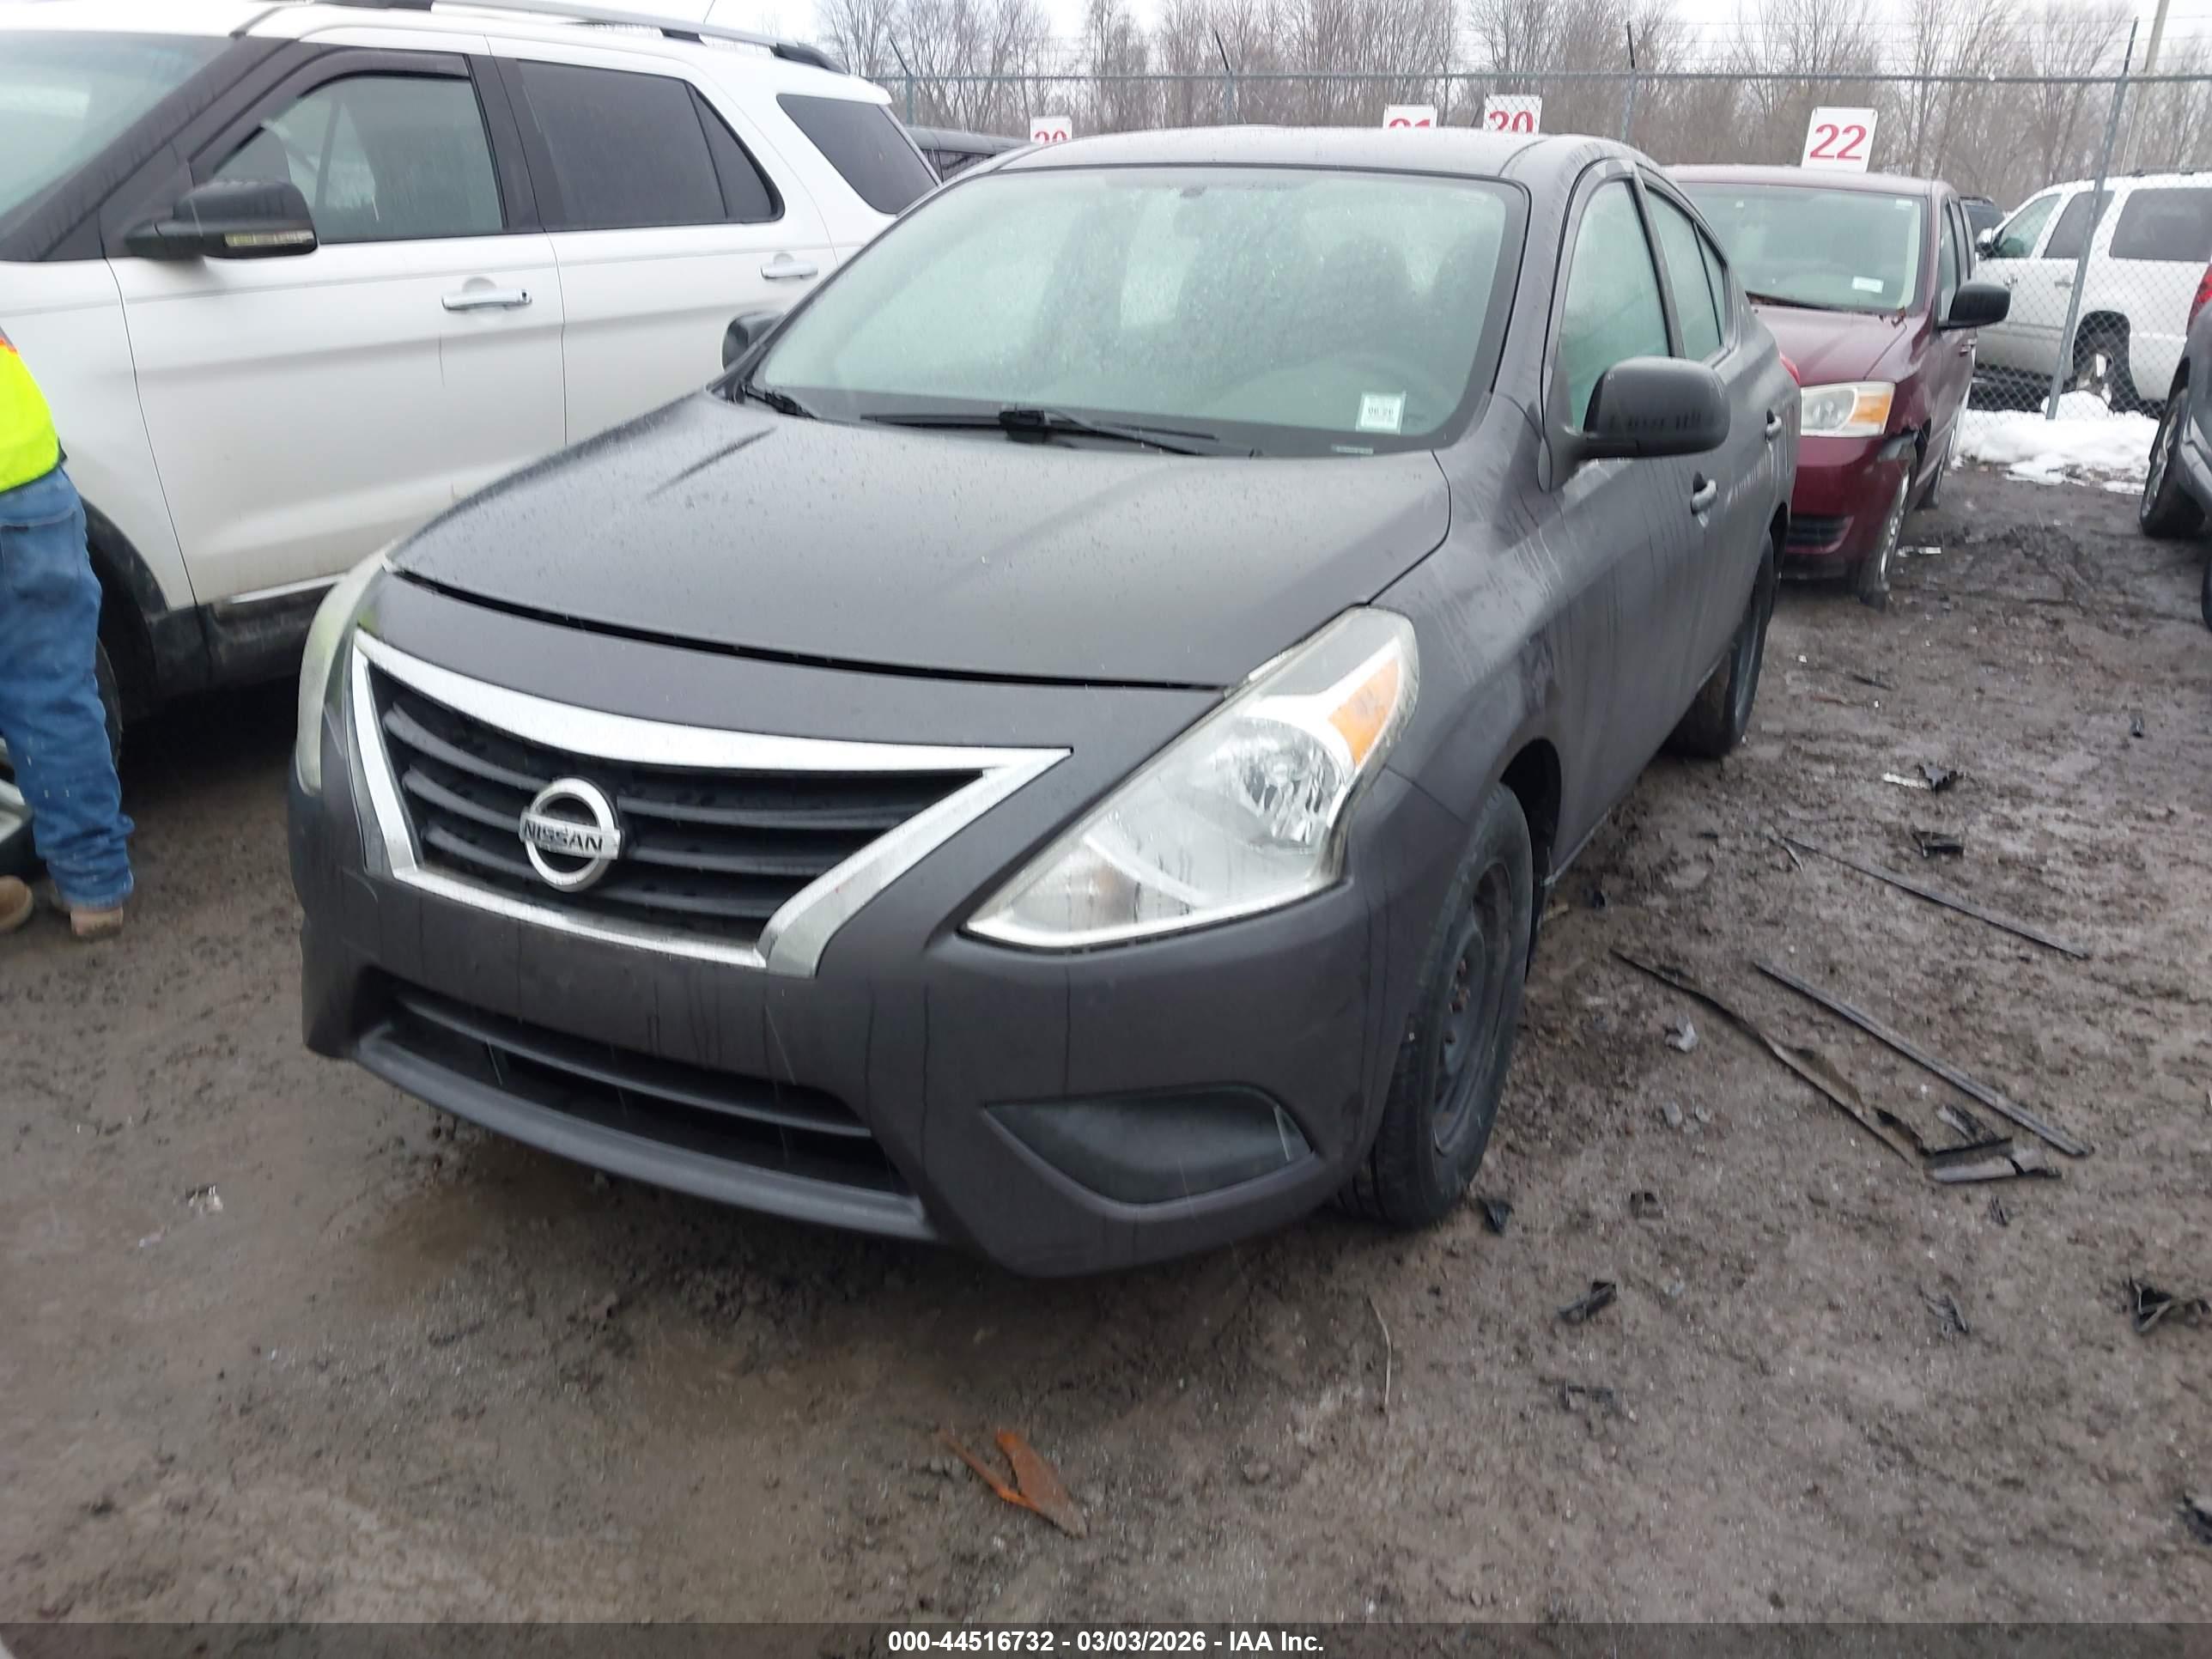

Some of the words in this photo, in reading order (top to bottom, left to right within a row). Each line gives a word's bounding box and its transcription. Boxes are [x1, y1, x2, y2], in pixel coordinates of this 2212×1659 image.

[1487, 110, 1534, 133] 20
[1809, 124, 1867, 160] 22
[525, 818, 603, 851] NISSAN
